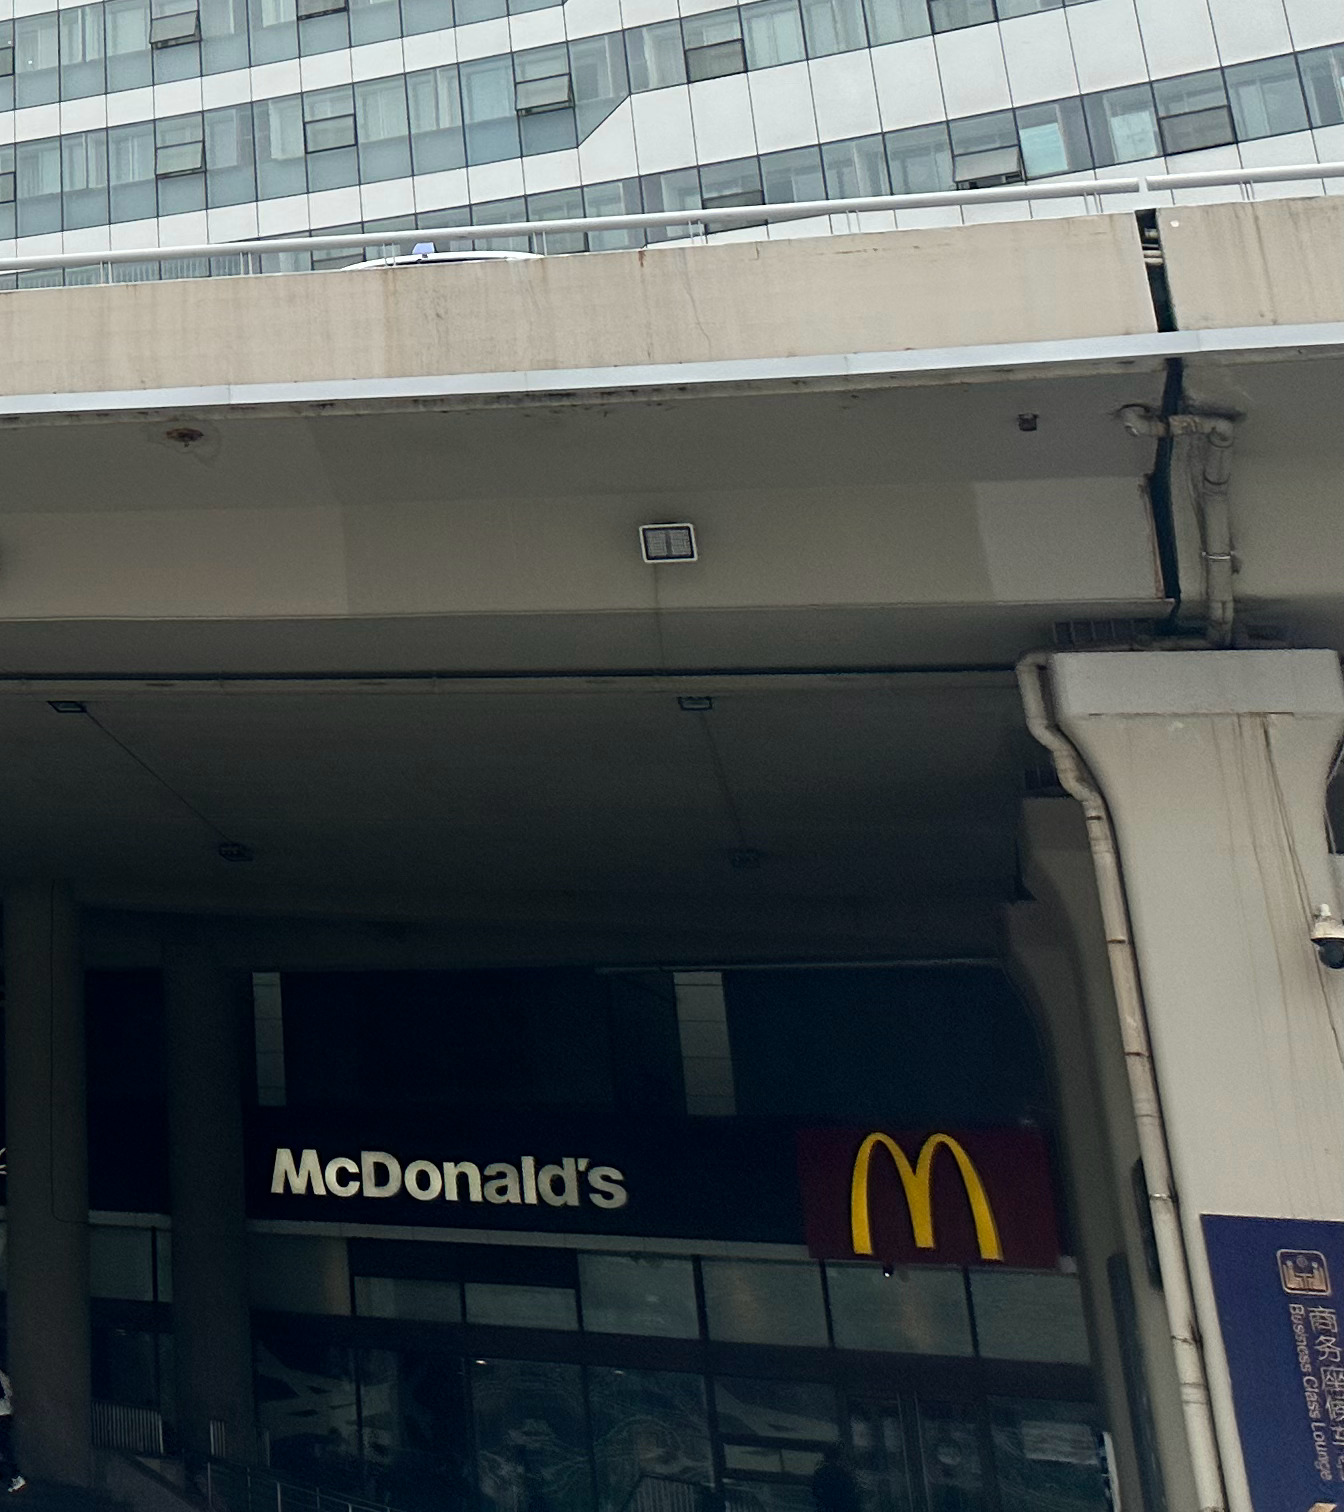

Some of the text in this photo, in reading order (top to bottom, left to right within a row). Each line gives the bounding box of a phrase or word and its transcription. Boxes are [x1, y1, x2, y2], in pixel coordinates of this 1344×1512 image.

[269, 1147, 629, 1210] McDonald's
[1289, 1304, 1333, 1481] Business Class Lounge
